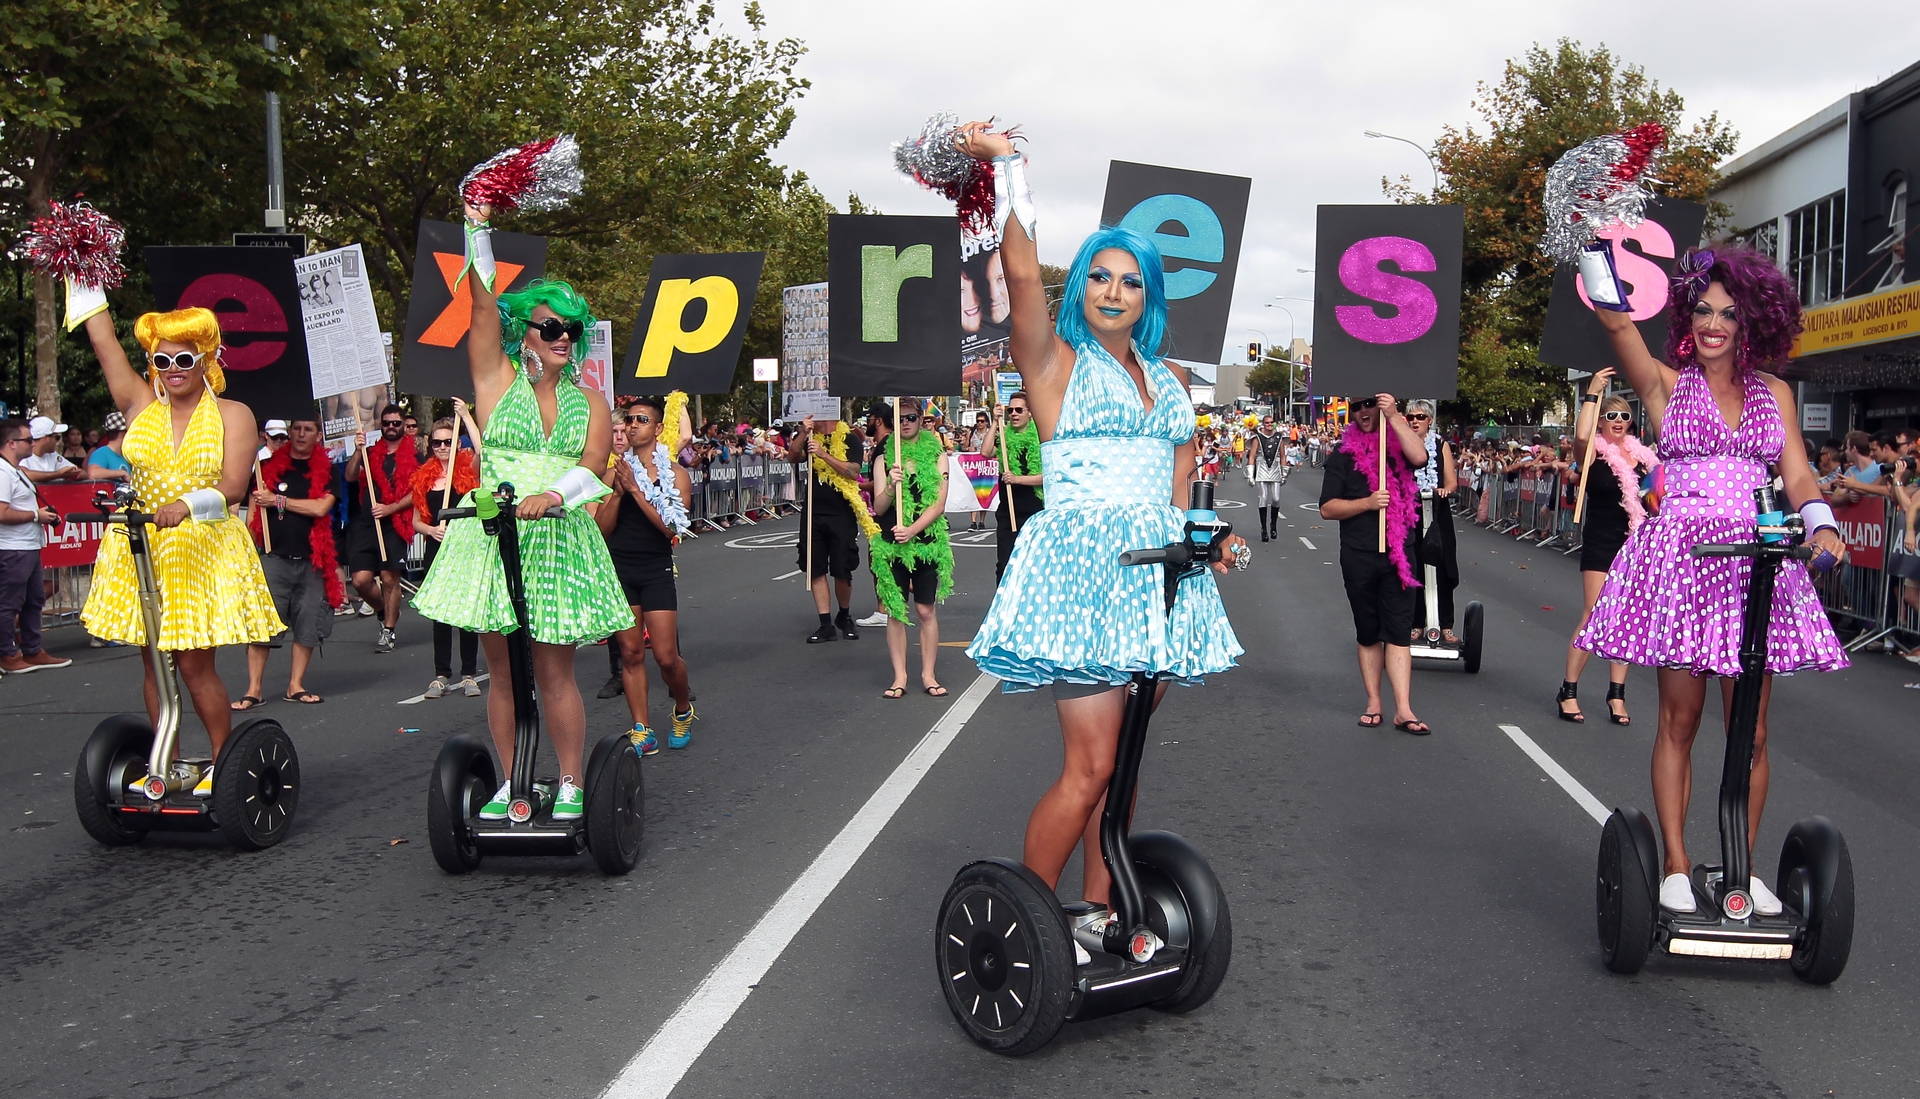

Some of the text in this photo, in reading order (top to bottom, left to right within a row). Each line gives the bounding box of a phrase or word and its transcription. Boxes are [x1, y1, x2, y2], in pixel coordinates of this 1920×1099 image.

[960, 235, 1000, 263] pre
[1118, 194, 1225, 300] e
[308, 259, 317, 271] to
[319, 255, 341, 269] MAN
[417, 252, 525, 348] x
[860, 244, 933, 343] r
[1335, 236, 1438, 344] s
[177, 273, 289, 371] e
[314, 312, 331, 320] EXPO
[332, 308, 345, 316] FOR
[1807, 290, 1920, 334] MUTIARA MALAYSIAN RESTAU
[306, 317, 342, 330] AUCKLAND
[635, 275, 739, 377] p
[1863, 323, 1888, 336] LICENCED
[1890, 322, 1895, 331] &
[1897, 319, 1908, 329] BYO
[710, 467, 736, 480] AUCKLAND
[742, 465, 763, 478] AUCKLAND
[769, 463, 791, 474] AUCKLAND
[962, 460, 999, 470] HAMILTO
[978, 466, 999, 477] PRIDE
[1836, 521, 1882, 548] KLAND
